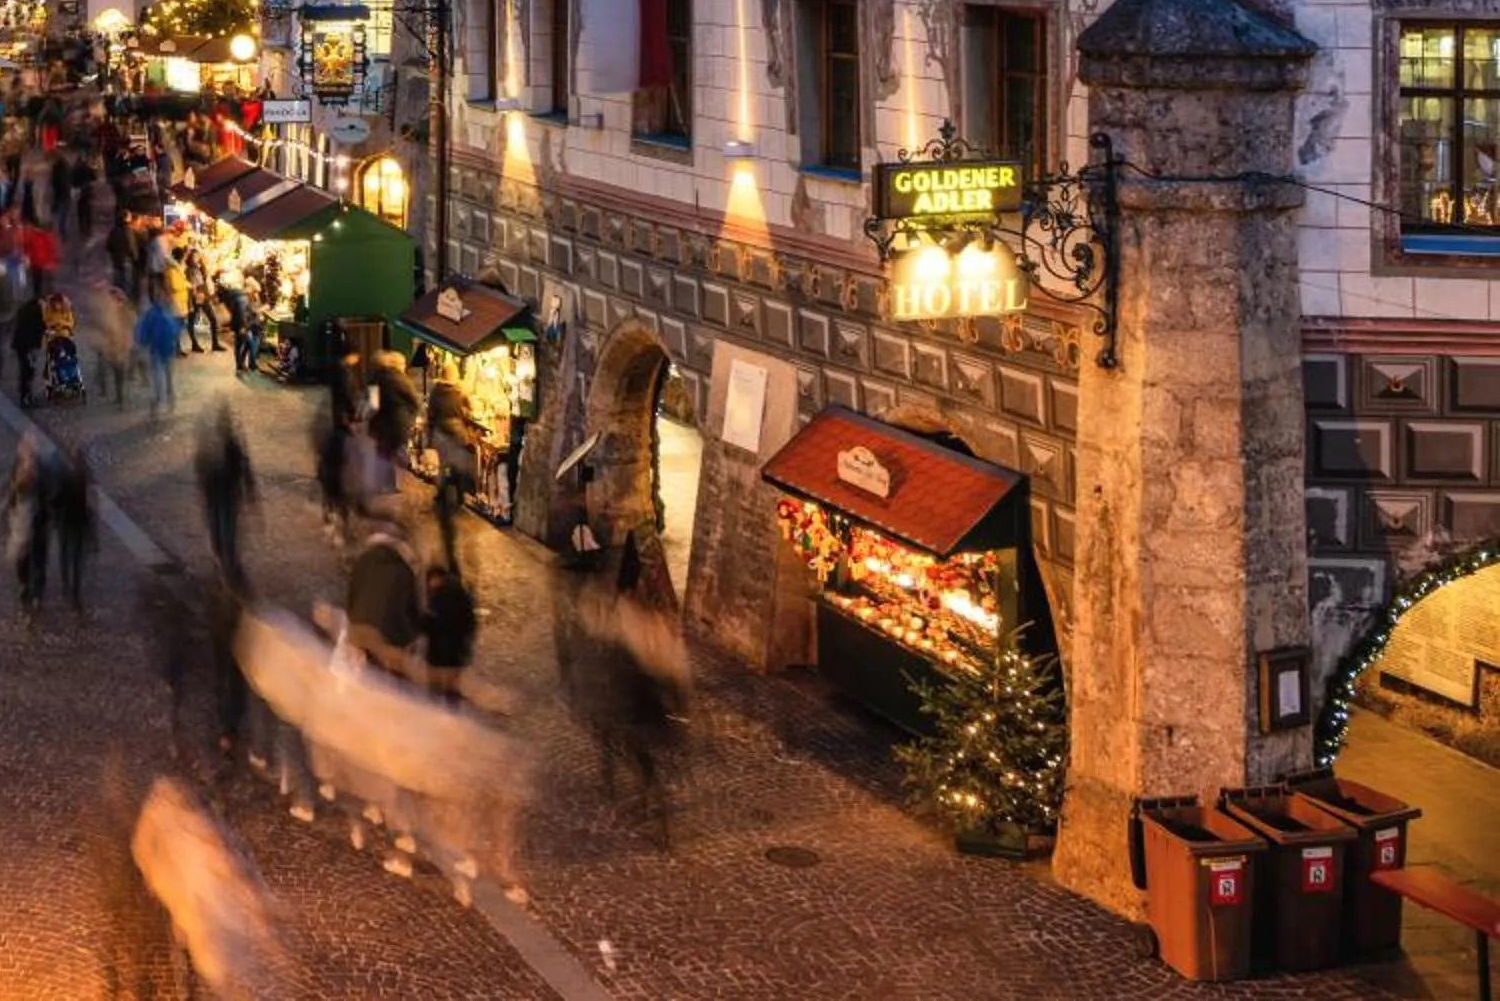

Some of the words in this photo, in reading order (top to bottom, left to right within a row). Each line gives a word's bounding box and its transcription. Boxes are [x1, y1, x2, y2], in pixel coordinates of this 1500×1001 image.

[894, 166, 1016, 193] GOLDENER
[912, 189, 994, 214] ADLER
[894, 279, 1027, 317] HOTEL
